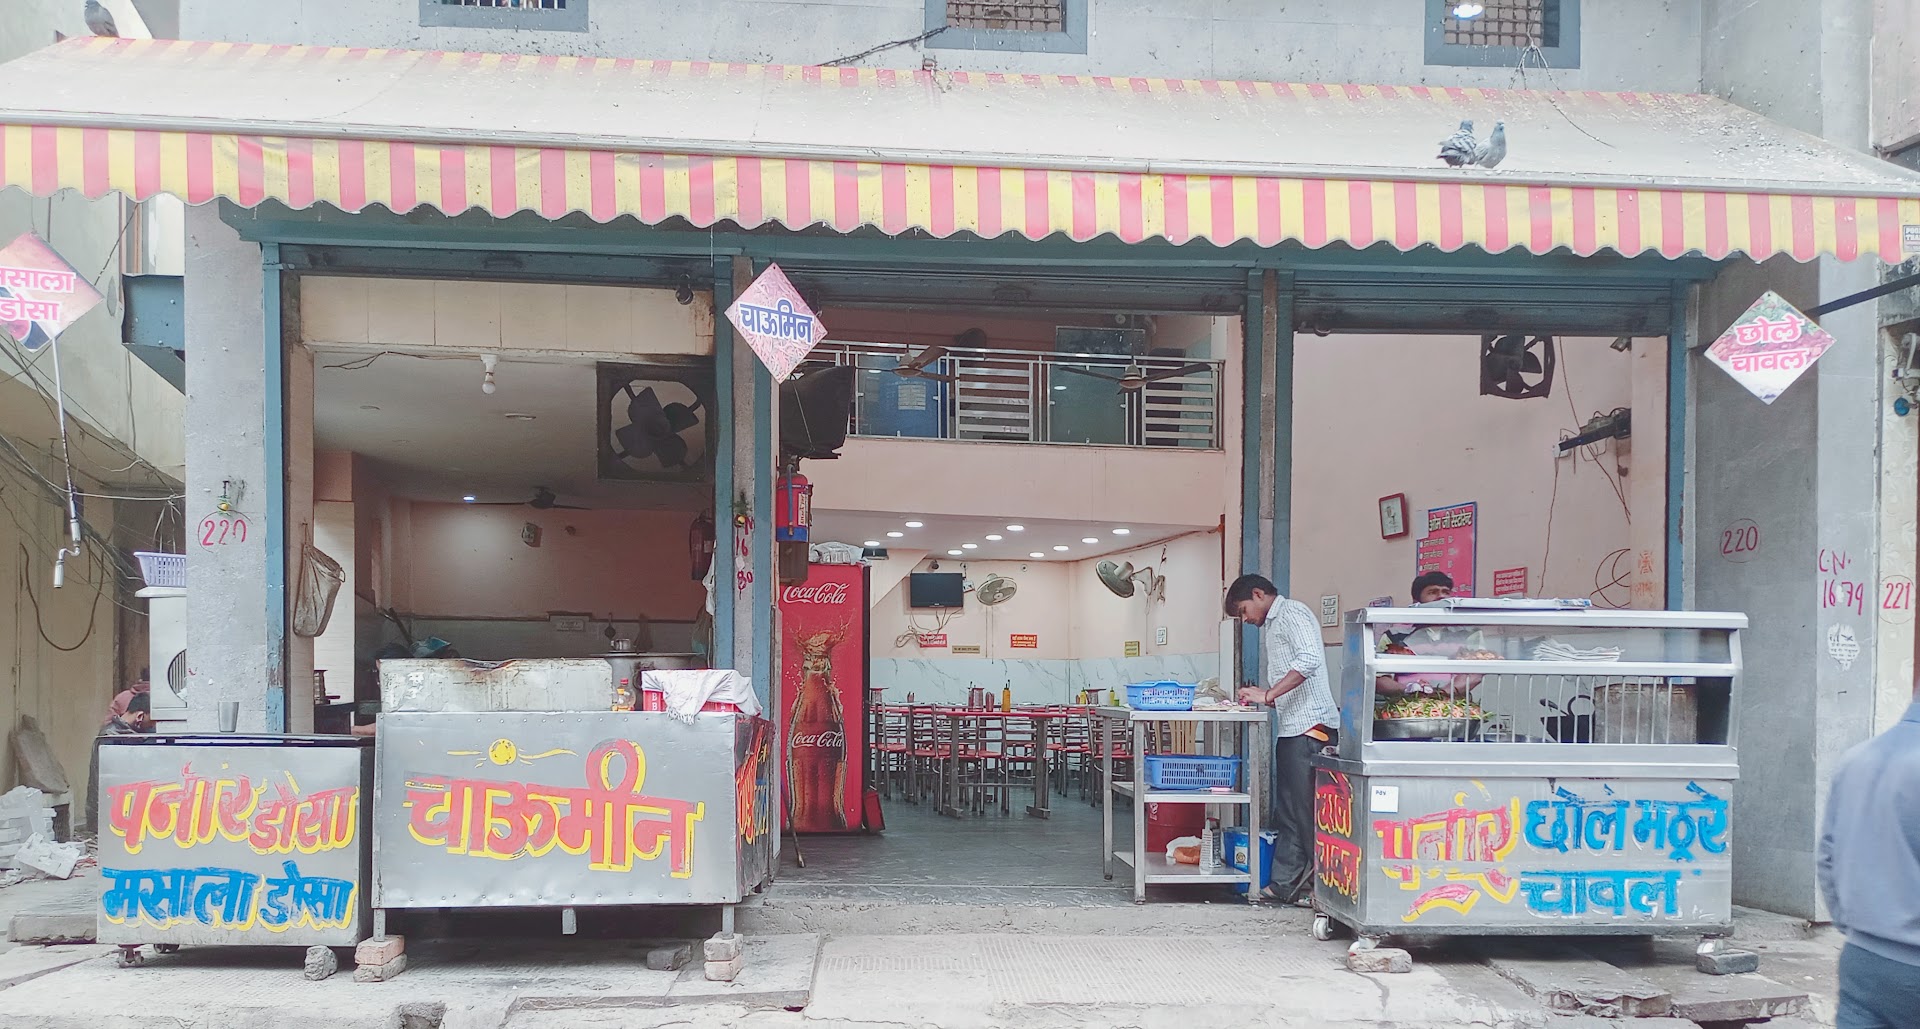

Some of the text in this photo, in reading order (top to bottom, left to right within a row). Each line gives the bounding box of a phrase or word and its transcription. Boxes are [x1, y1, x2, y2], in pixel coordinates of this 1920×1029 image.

[738, 298, 813, 344] चाऊमिन
[1735, 313, 1803, 344] छोले
[1730, 349, 1808, 373] चावल
[202, 519, 247, 546] 220
[1723, 526, 1759, 555] 220
[783, 582, 850, 604] Coca-Cola
[1883, 582, 1911, 610] 221
[791, 731, 844, 749] Coca-Cola
[248, 770, 359, 855] डोसा
[402, 738, 705, 879] चाऊमीन
[101, 860, 359, 933] मसाला डोसा
[1520, 869, 1684, 919] चावल
